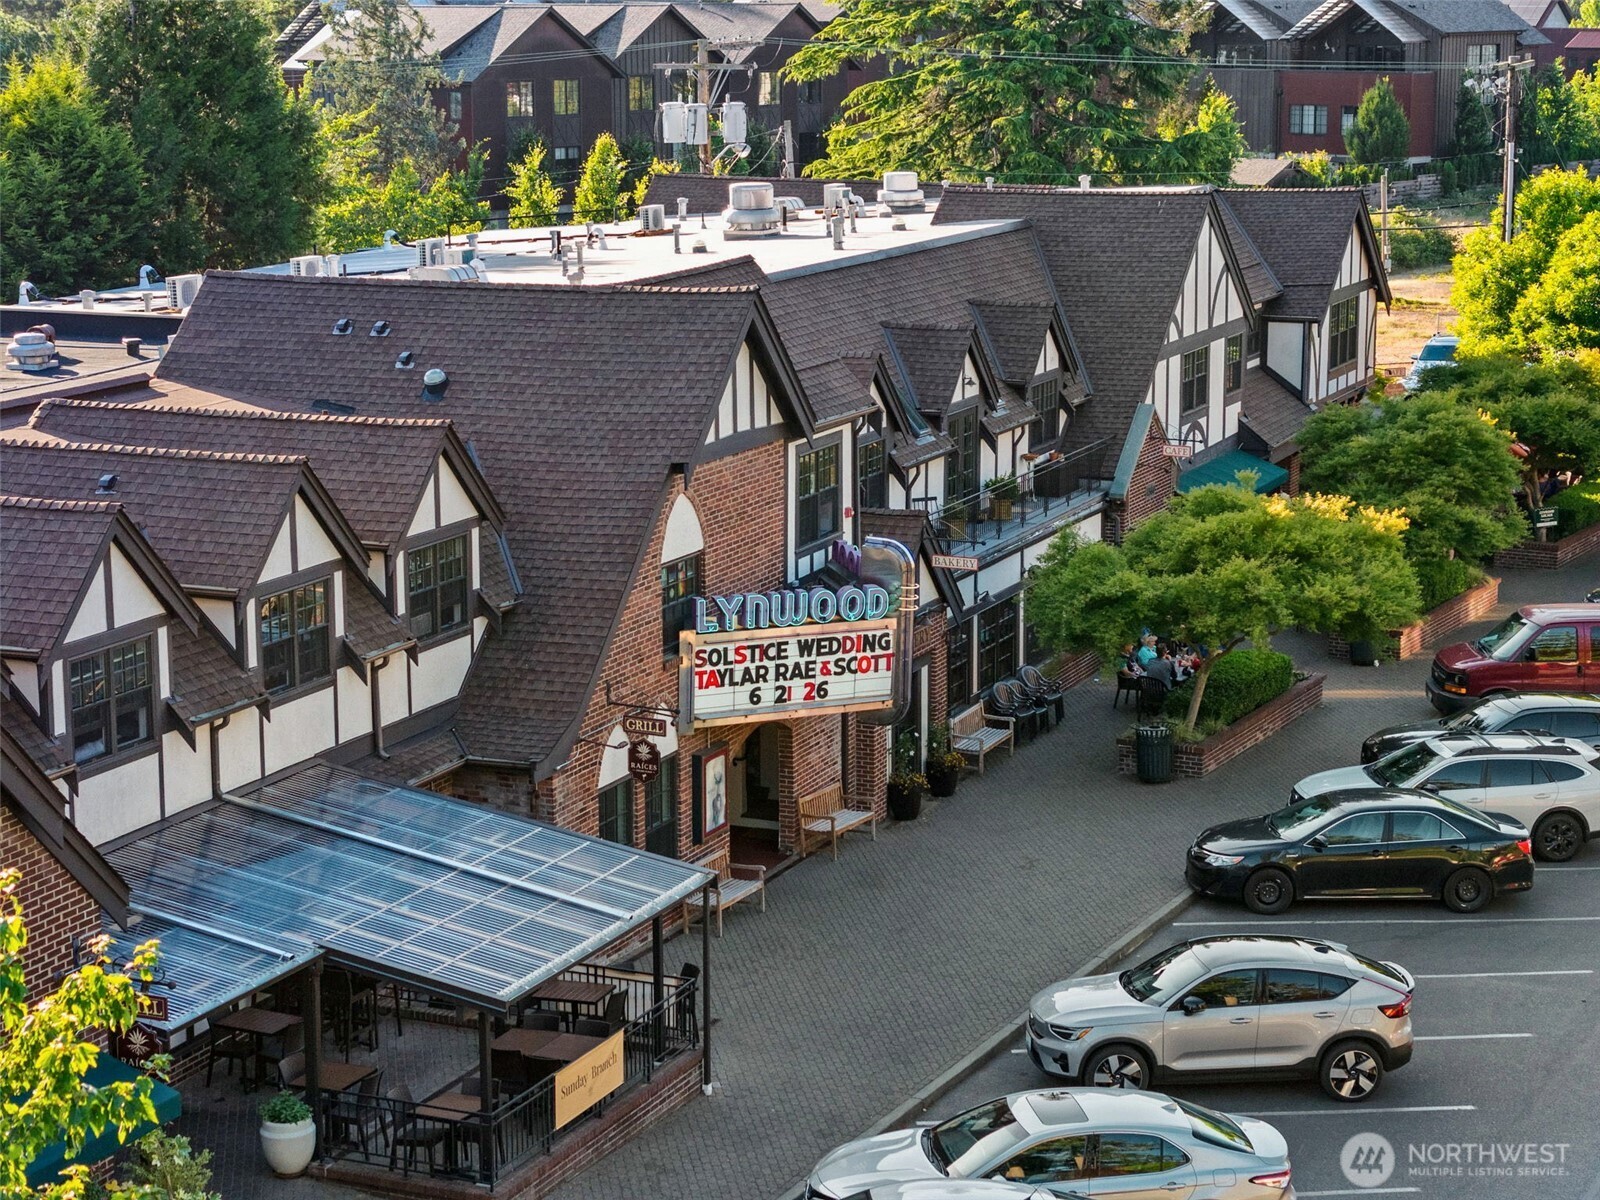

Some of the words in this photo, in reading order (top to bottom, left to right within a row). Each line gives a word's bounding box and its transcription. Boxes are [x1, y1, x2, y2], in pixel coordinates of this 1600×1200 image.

[1165, 447, 1188, 455] CAFE
[934, 557, 975, 568] BAKERY
[692, 584, 889, 633] LYNWOOD
[695, 641, 789, 668] SOLSTICE
[797, 632, 891, 658] WEDDING
[695, 662, 769, 690] TAYLAR
[775, 660, 816, 682] RAE
[749, 687, 762, 705] 6
[804, 681, 829, 701] 26
[626, 719, 662, 732] GRILL
[630, 762, 657, 770] RAÍCES
[561, 1074, 588, 1099] Sunday
[591, 1051, 618, 1079] Brunch
